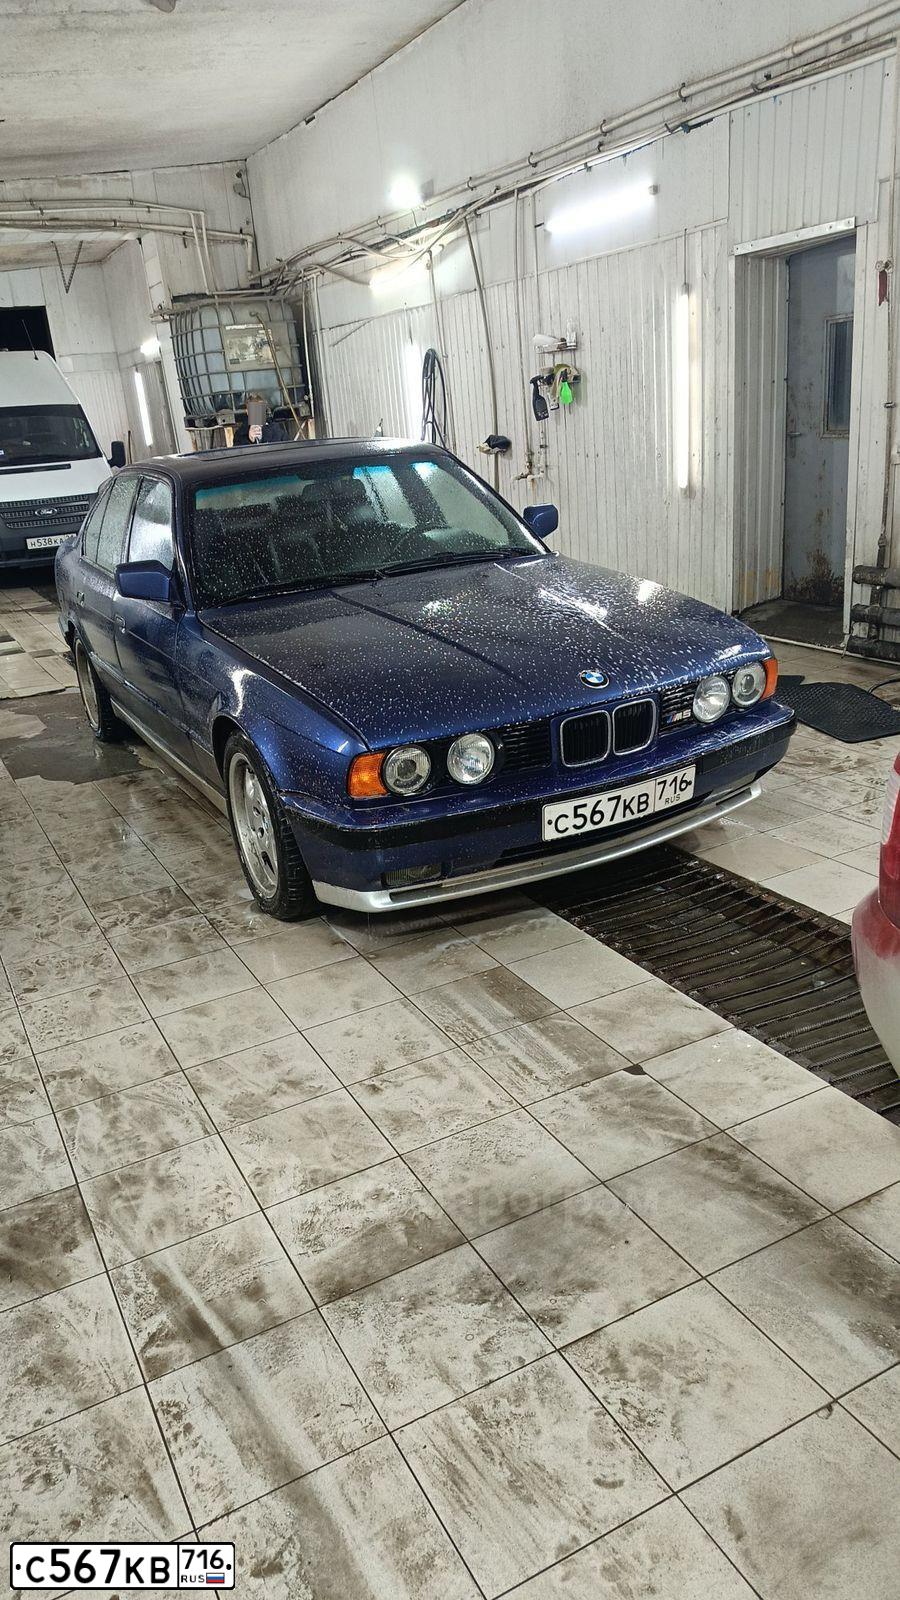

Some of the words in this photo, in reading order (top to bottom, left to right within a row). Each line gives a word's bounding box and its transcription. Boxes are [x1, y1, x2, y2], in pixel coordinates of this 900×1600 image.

[554, 793, 650, 834] С567КВ
[657, 773, 688, 800] 716
[664, 793, 681, 805] RUS
